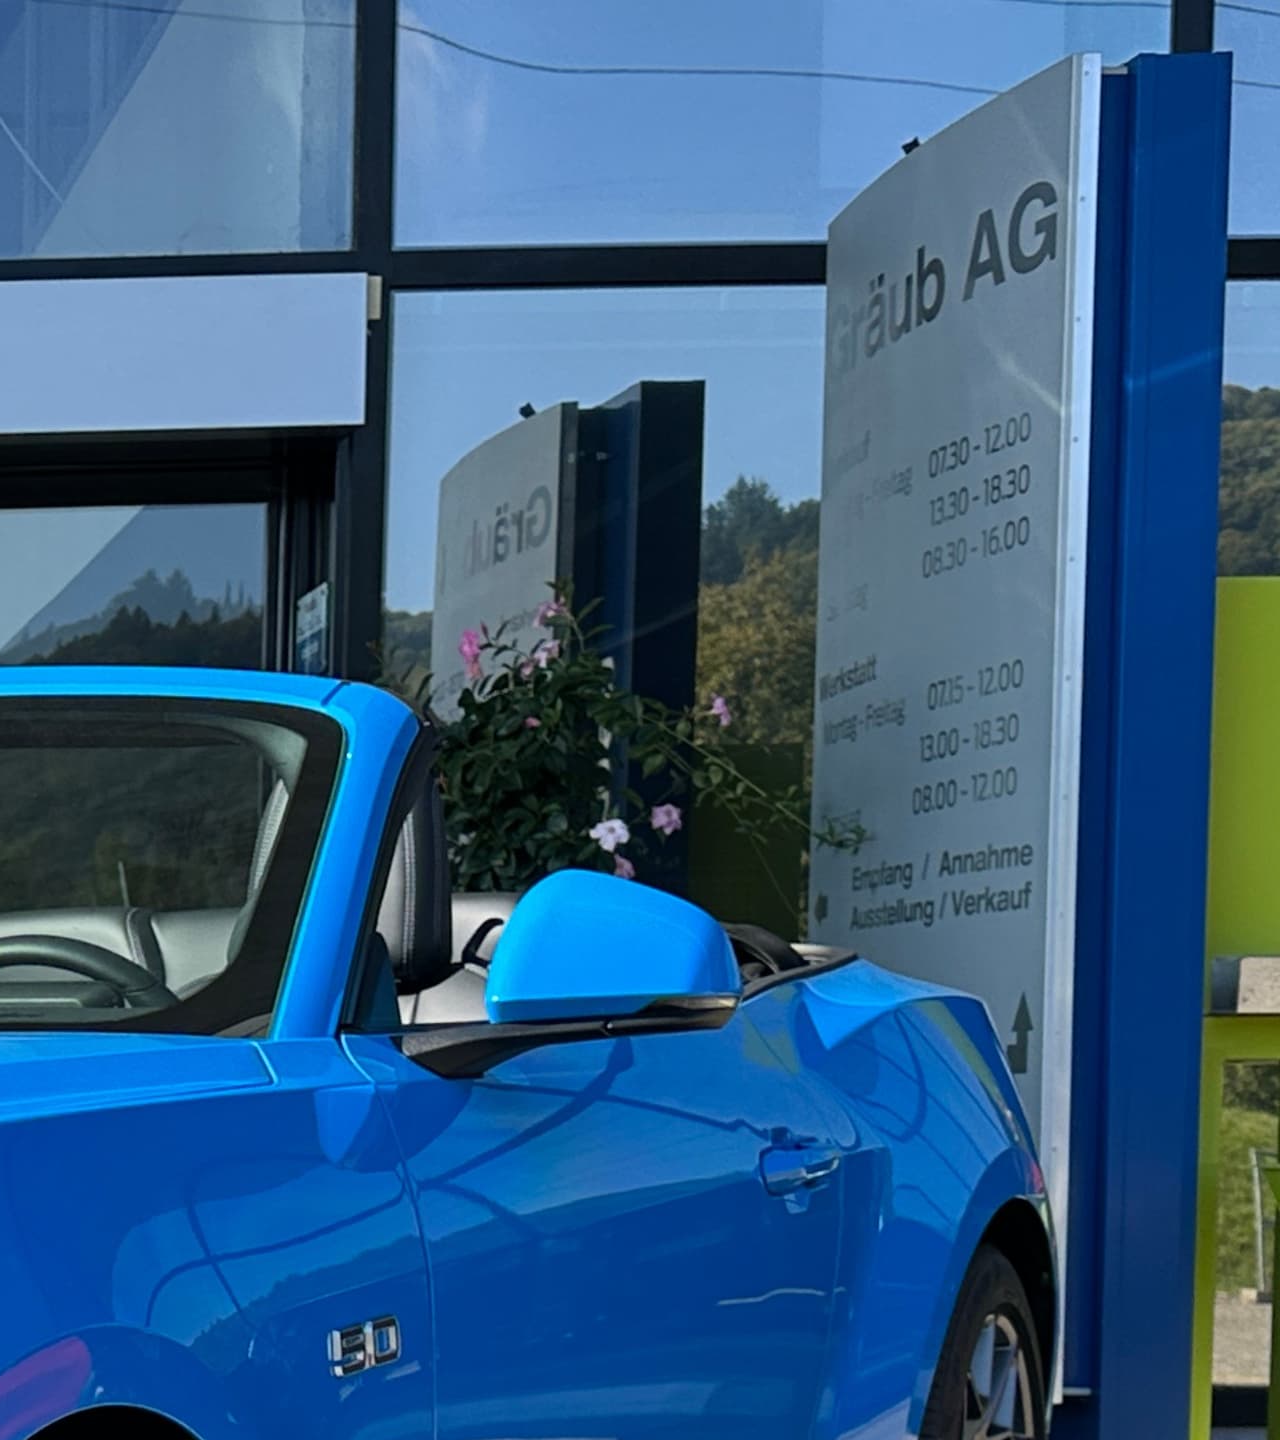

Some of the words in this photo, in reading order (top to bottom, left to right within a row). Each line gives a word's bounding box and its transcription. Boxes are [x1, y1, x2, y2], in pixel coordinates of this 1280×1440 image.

[831, 244, 946, 374] Gräub
[961, 180, 1059, 304] AG
[983, 463, 1031, 507] 18.30
[981, 515, 1031, 559] 16.00
[973, 712, 1020, 750] 18.30
[971, 765, 1018, 802] 12.00
[851, 860, 914, 895] Empfang
[937, 843, 1034, 878] Annahme
[849, 898, 935, 931] Ausstellung
[951, 880, 1033, 917] Verkauf
